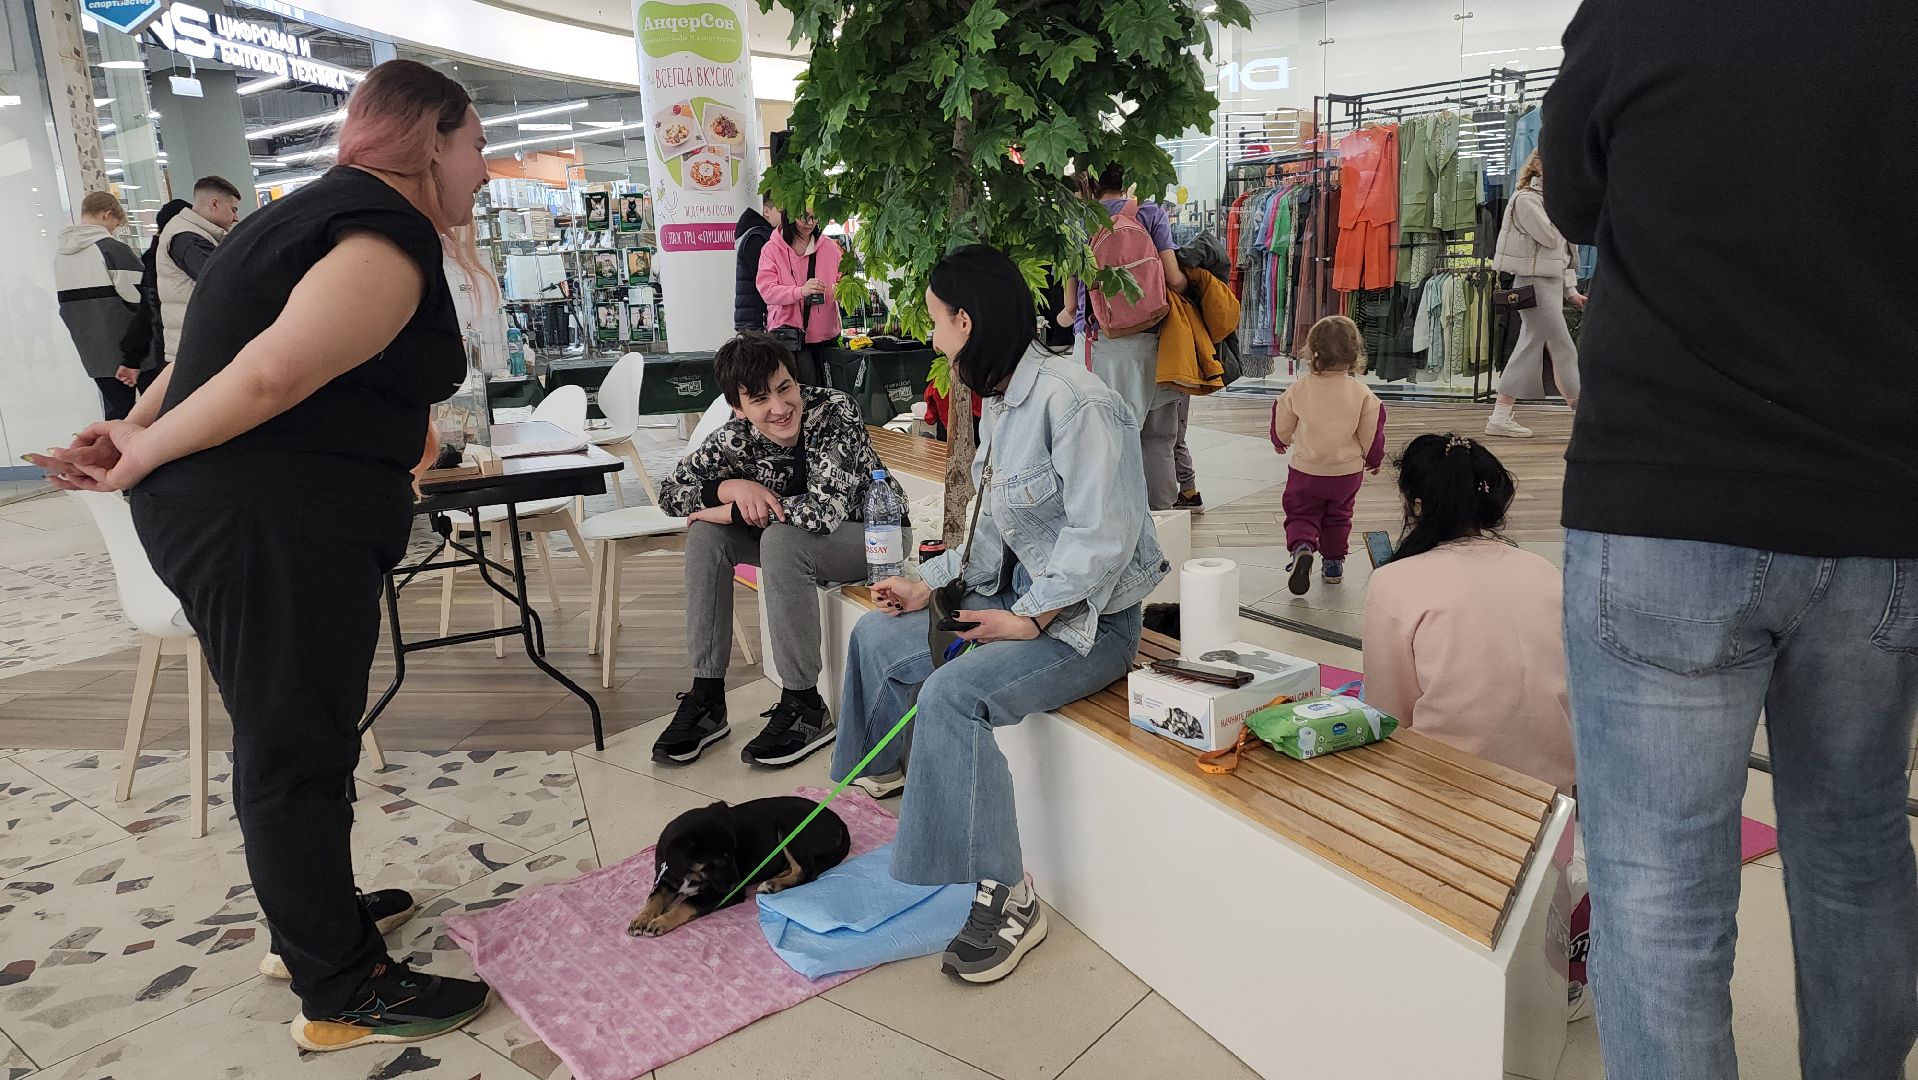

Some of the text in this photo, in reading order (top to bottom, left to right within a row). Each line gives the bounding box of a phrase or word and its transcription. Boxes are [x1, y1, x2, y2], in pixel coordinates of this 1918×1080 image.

[215, 13, 311, 58] ЦИФРОВАЯ И
[220, 43, 349, 91] БЫТОВАЯ ТЕХНИКА
[656, 66, 734, 89] ВСЕГДА ВКУСНО
[1220, 712, 1244, 728] НАЧНИТЕ
